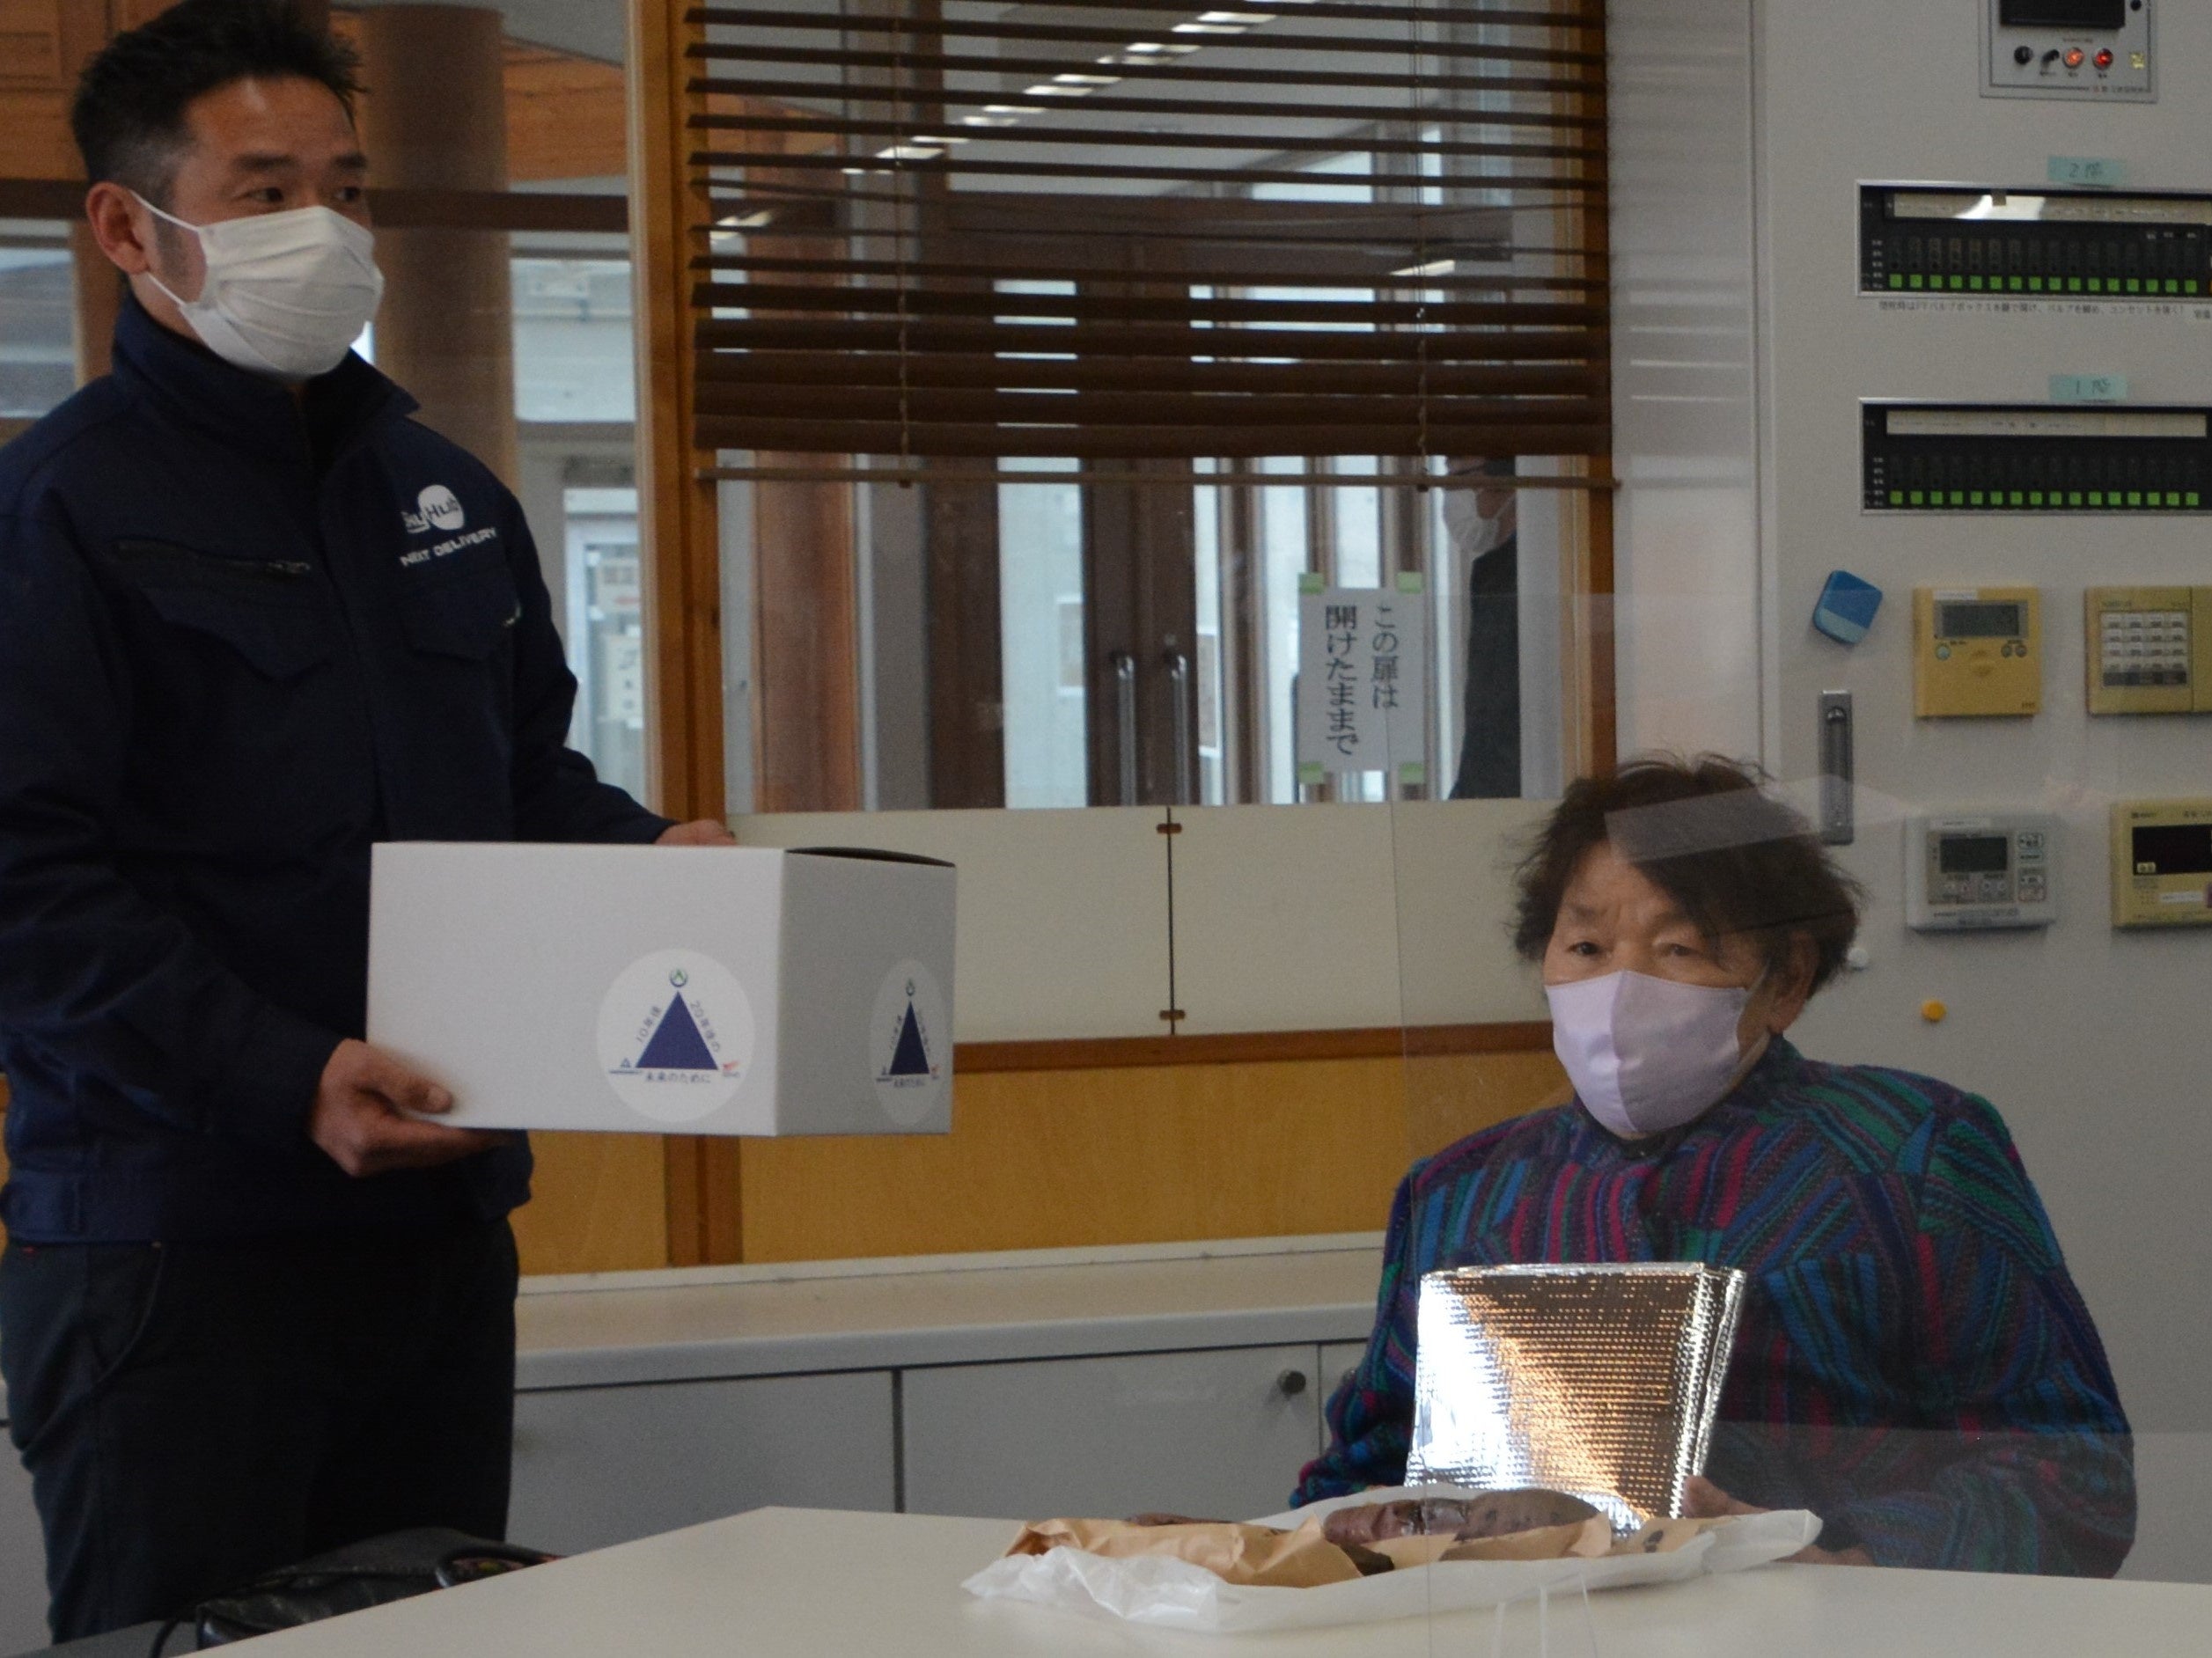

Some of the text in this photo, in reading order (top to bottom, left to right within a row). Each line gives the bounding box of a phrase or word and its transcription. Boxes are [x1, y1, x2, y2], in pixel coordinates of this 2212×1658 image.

[432, 527, 497, 557] DELIVERY
[1325, 605, 1359, 756] 開けたままで
[1371, 605, 1400, 709] この扉は
